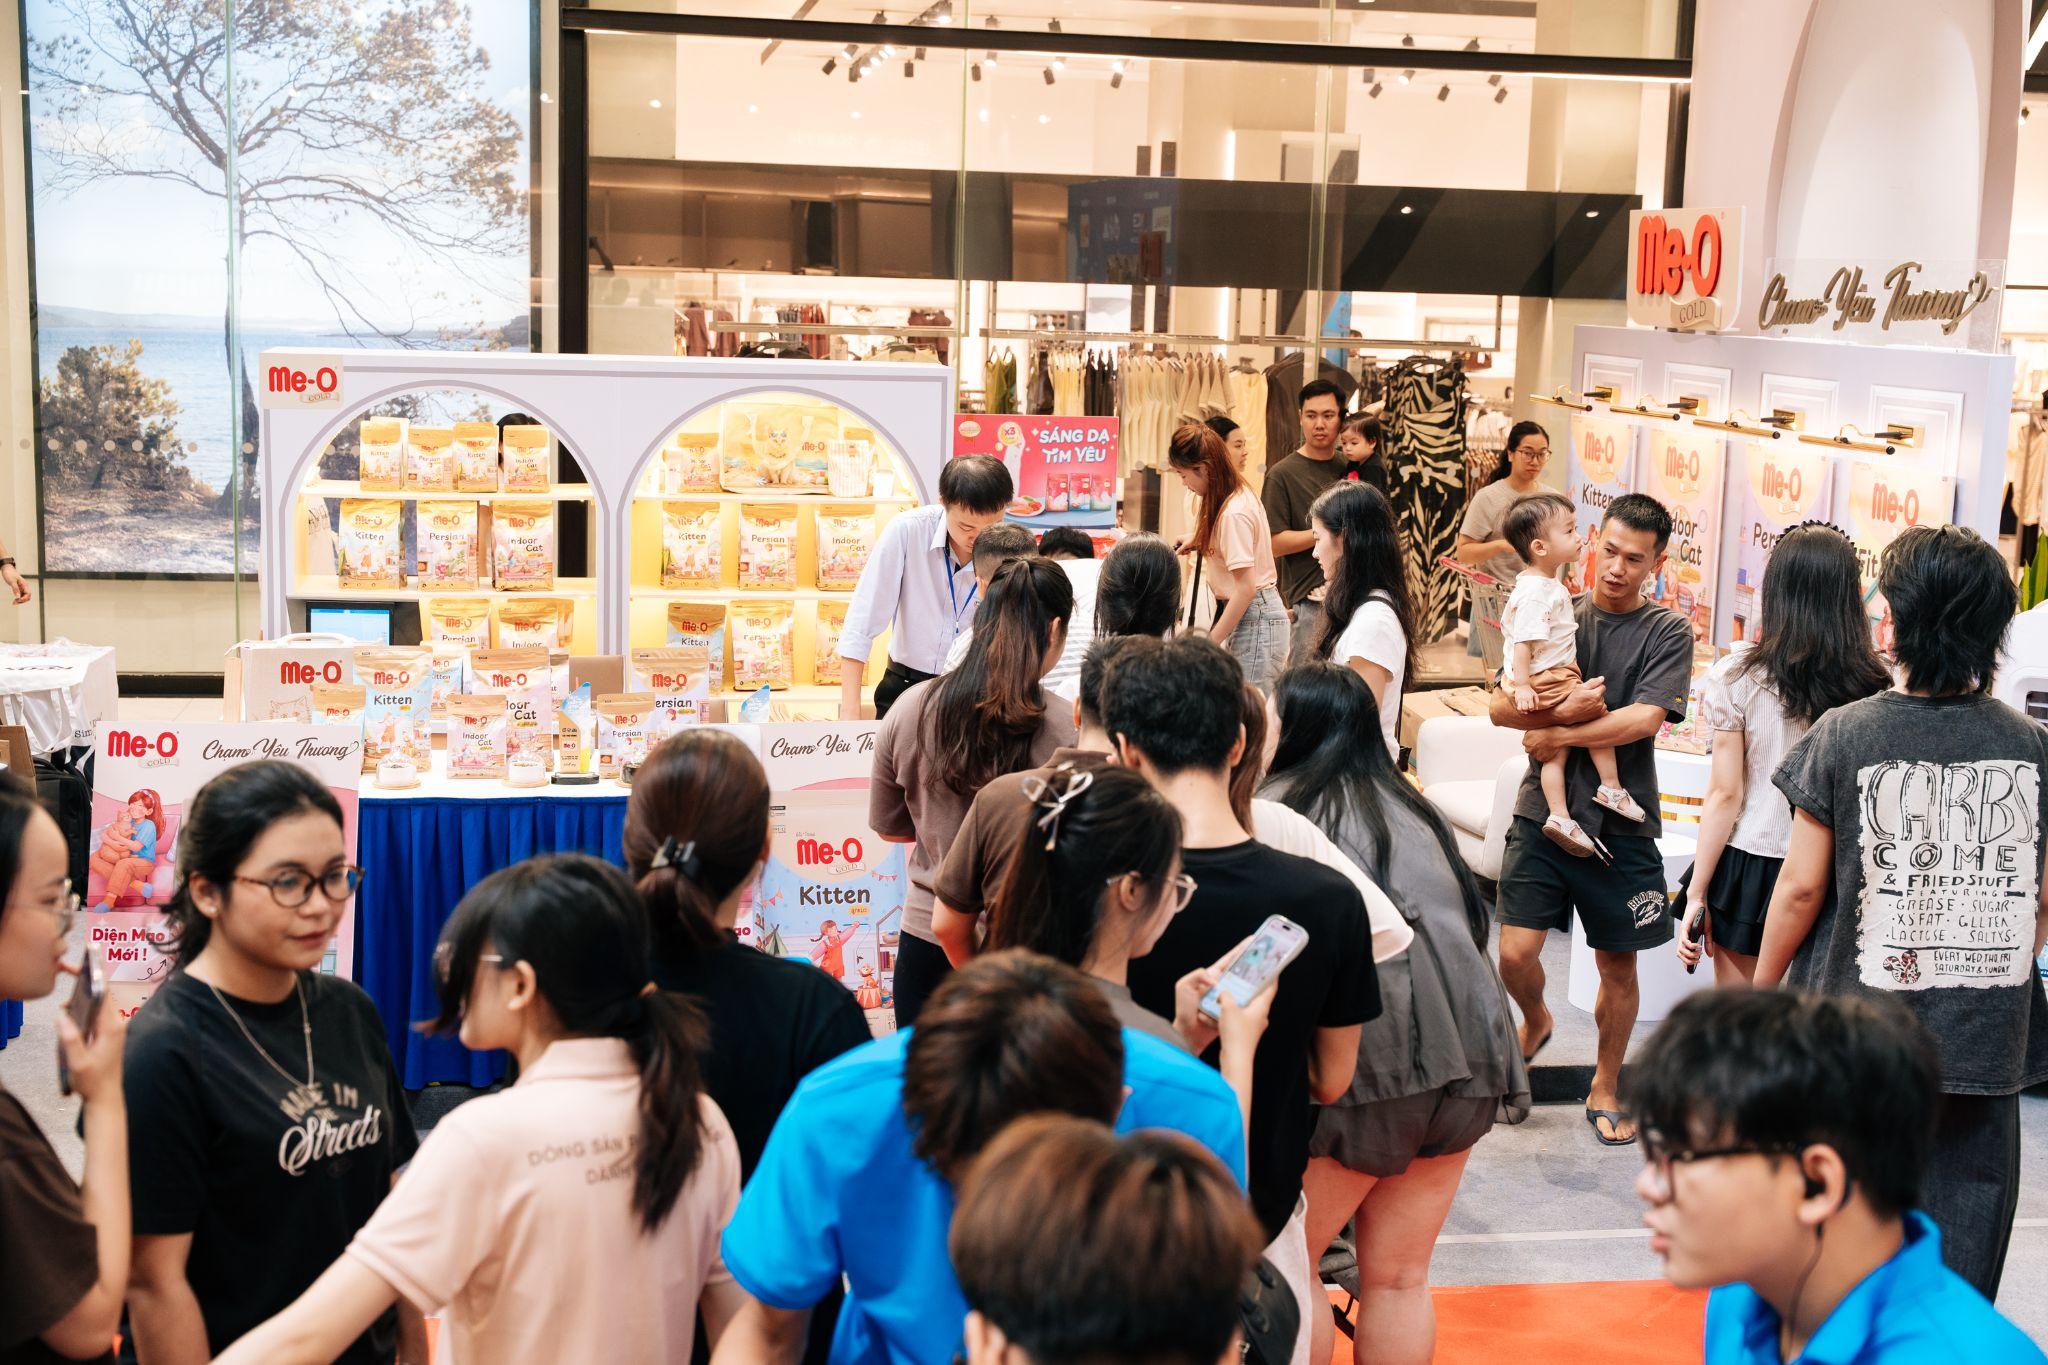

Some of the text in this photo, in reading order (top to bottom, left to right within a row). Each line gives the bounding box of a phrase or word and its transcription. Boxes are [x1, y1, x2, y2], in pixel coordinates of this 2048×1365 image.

[1636, 214, 1722, 297] Me-O
[1679, 300, 1707, 324] GOLD
[269, 366, 338, 393] Me-O
[1039, 426, 1084, 443] SÁNG
[1074, 446, 1106, 462] YÊU
[1584, 431, 1615, 464] Me-O
[1665, 446, 1700, 481] Me-O
[1762, 462, 1802, 502] Me-O
[1871, 482, 1920, 526] Me-O
[432, 515, 460, 526] Me-O
[508, 516, 536, 529] Me-O
[355, 531, 385, 541] Kitten
[507, 536, 539, 545] Indoor
[678, 532, 707, 541] Kitten
[751, 534, 785, 543] Persian
[832, 536, 861, 544] Indoor
[525, 543, 544, 552] Cat
[849, 544, 866, 553] Cat
[1680, 539, 1703, 567] Cat
[445, 616, 472, 629] Me-O
[514, 619, 542, 632] Me-O
[681, 620, 708, 633] Me-O
[746, 617, 772, 629] Me-O
[681, 638, 709, 647] Kitten
[280, 660, 342, 685] Me-O
[373, 671, 410, 685] Me-O
[491, 673, 528, 688] Me-O
[651, 673, 688, 688] Me-O
[373, 694, 413, 706] Kitten
[655, 697, 693, 709] ersian
[326, 708, 350, 717] Me-O
[514, 709, 537, 721] Cat
[464, 715, 488, 726] Me-O
[614, 714, 638, 725] Me-O
[462, 732, 489, 740] Indoor
[612, 730, 642, 738] Persian
[107, 730, 178, 758] Me-O
[202, 736, 360, 762] Chạm Yêu Thương
[478, 739, 493, 747] Cat
[770, 737, 817, 759] Chạm
[816, 734, 851, 756] Yêu
[1866, 760, 2034, 844] CARBS
[796, 837, 863, 865] Me-O
[1873, 842, 2018, 872] COME
[1883, 873, 2019, 888] & FRIED STUFF
[799, 884, 871, 906] Kitten
[1906, 888, 1999, 898] FEATURING
[1896, 898, 2010, 913] GREASE SUGAR
[92, 928, 128, 945] Diện
[108, 948, 139, 961] Mới
[1933, 950, 1960, 962] EVERY
[1934, 963, 1976, 973] SATURDAY
[1984, 965, 2011, 974] SUNDAY
[333, 1082, 360, 1110] IN
[278, 1103, 383, 1177] Streets
